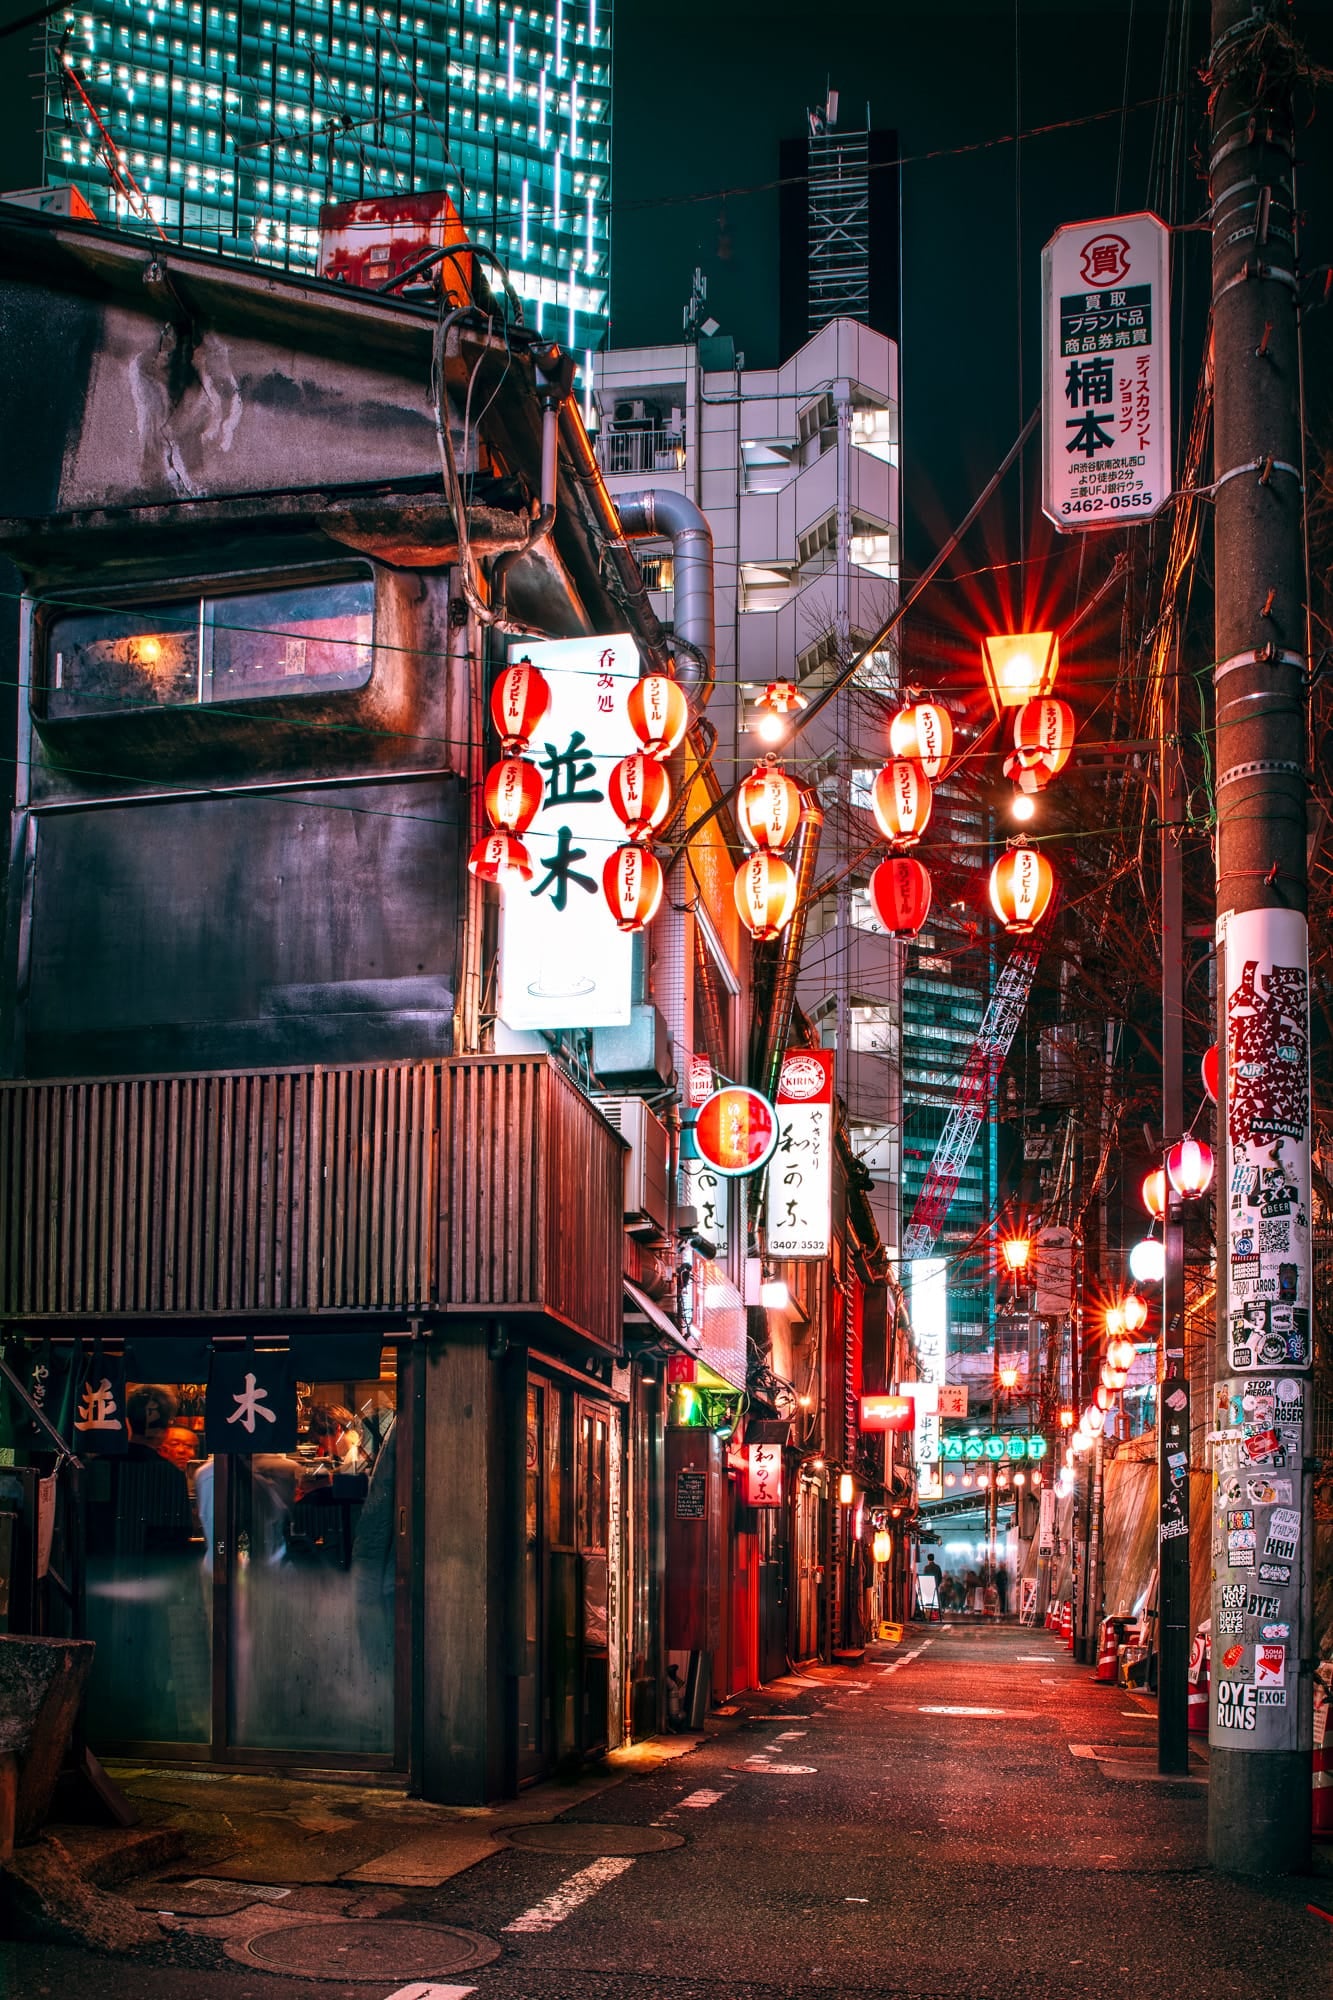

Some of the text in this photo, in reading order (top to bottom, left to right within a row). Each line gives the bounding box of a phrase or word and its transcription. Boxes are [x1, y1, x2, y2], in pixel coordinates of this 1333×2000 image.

[1091, 244, 1120, 278] 質
[1085, 291, 1127, 312] 買取
[1068, 309, 1144, 335] ブランド品
[1065, 328, 1147, 354] 商品券売買
[1065, 356, 1115, 458] 楠本
[1119, 378, 1134, 433] ショップ
[1136, 355, 1151, 450] ディスカウント
[1078, 468, 1135, 486] より徒歩2分
[1061, 492, 1153, 515] 3462-0555
[508, 669, 522, 717] キリンビール
[597, 647, 615, 713] 呑み処
[922, 712, 937, 764] キリンビール
[626, 756, 638, 801] キリンビール
[899, 767, 913, 815] キリンビール
[530, 730, 605, 912] 並木
[624, 851, 636, 902] キリンビール
[752, 860, 764, 910] キリンビール
[1020, 855, 1031, 903] キリンビール
[786, 1077, 814, 1086] KIRIN
[1267, 1202, 1290, 1214] BEER
[1252, 1278, 1276, 1293] LARGOS
[1247, 1380, 1272, 1389] STOP
[75, 1372, 277, 1434] 並 木
[938, 1437, 1047, 1459] んべい横丁
[1222, 1584, 1247, 1593] FEAR
[1223, 1592, 1246, 1601] NOIZ
[1224, 1600, 1244, 1608] DCV
[1247, 1595, 1274, 1618] BYE
[1220, 1625, 1244, 1634] ZEE
[1218, 1680, 1258, 1706] OYE
[1259, 1691, 1286, 1705] EXOE
[1217, 1703, 1256, 1730] RUNS
